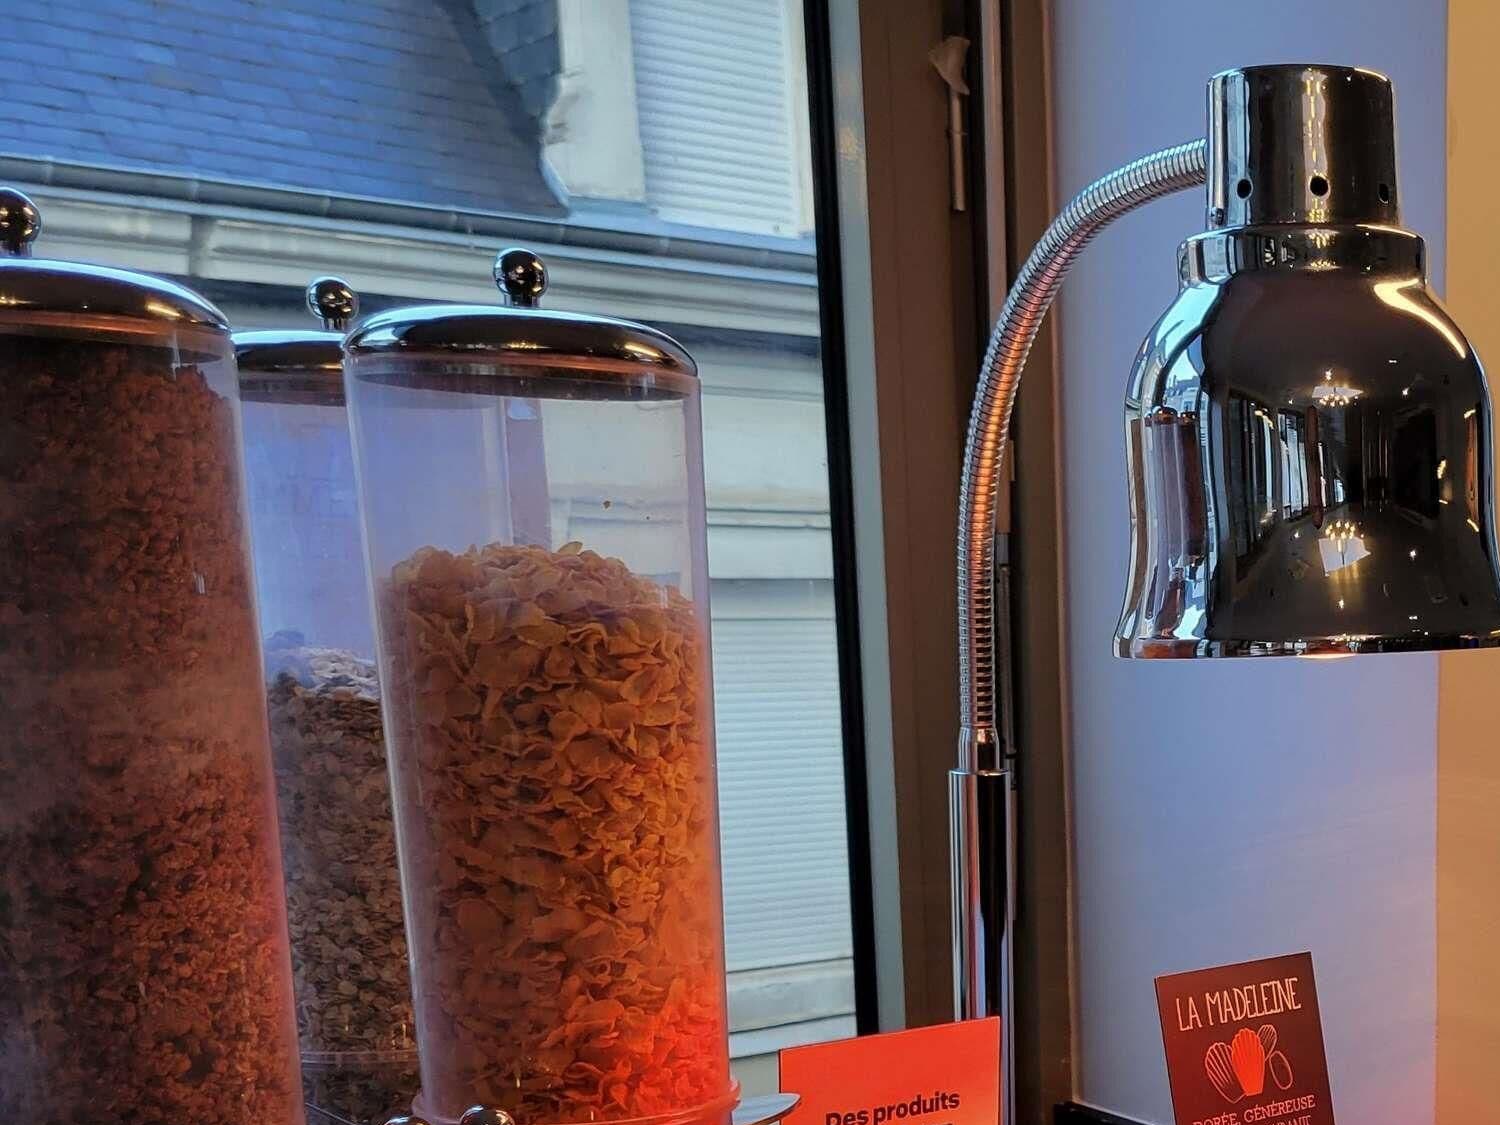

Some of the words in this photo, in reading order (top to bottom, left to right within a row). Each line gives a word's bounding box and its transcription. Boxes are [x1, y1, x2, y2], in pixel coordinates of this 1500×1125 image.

[1176, 995, 1203, 1032] LA
[1205, 977, 1302, 1027] MADELEINE
[1244, 1095, 1316, 1124] GÉNÉREUSE
